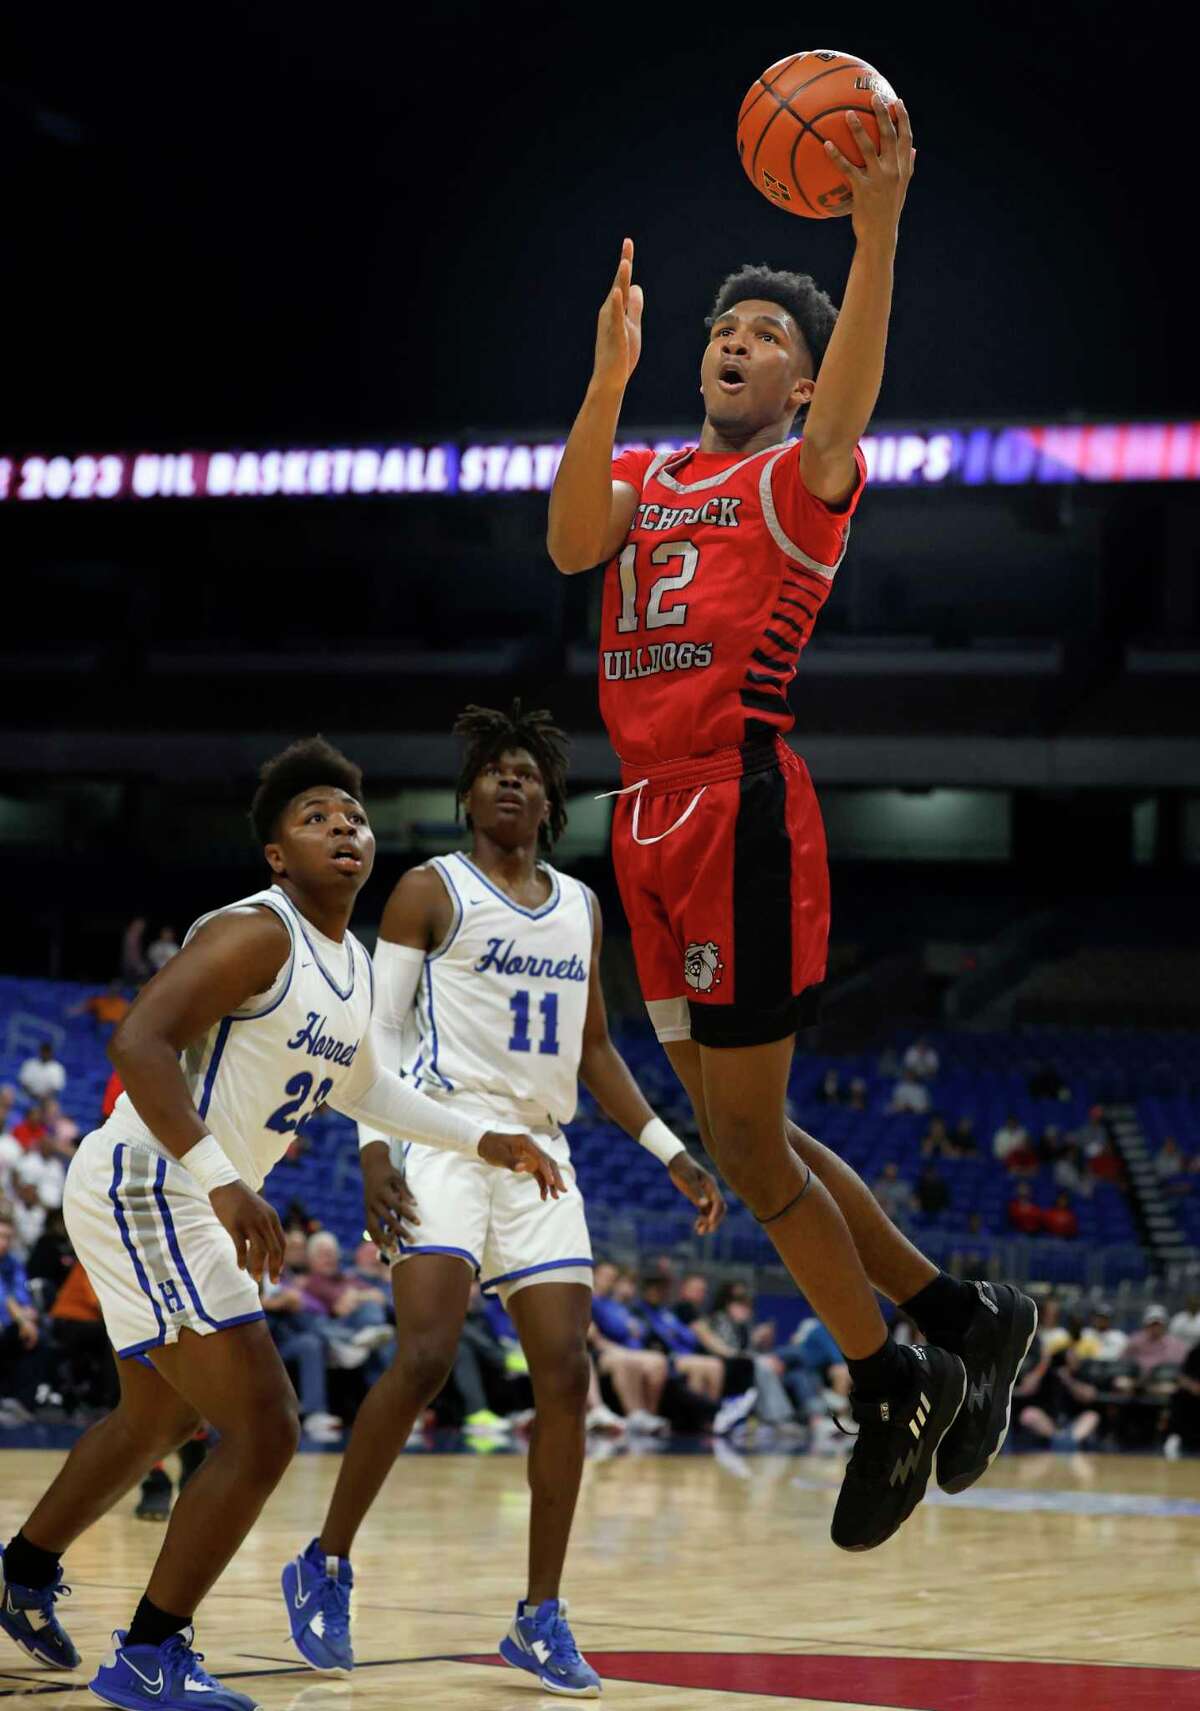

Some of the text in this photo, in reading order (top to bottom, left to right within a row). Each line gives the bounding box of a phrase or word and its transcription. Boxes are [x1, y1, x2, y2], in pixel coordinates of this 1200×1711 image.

[19, 456, 123, 499] 2023
[132, 454, 195, 497] UIL
[206, 449, 447, 495] BASKETBALL
[459, 445, 565, 491] STAT
[616, 540, 699, 633] 12
[474, 937, 587, 982] Hornets
[508, 989, 560, 1056] 11
[157, 1278, 186, 1314] H
